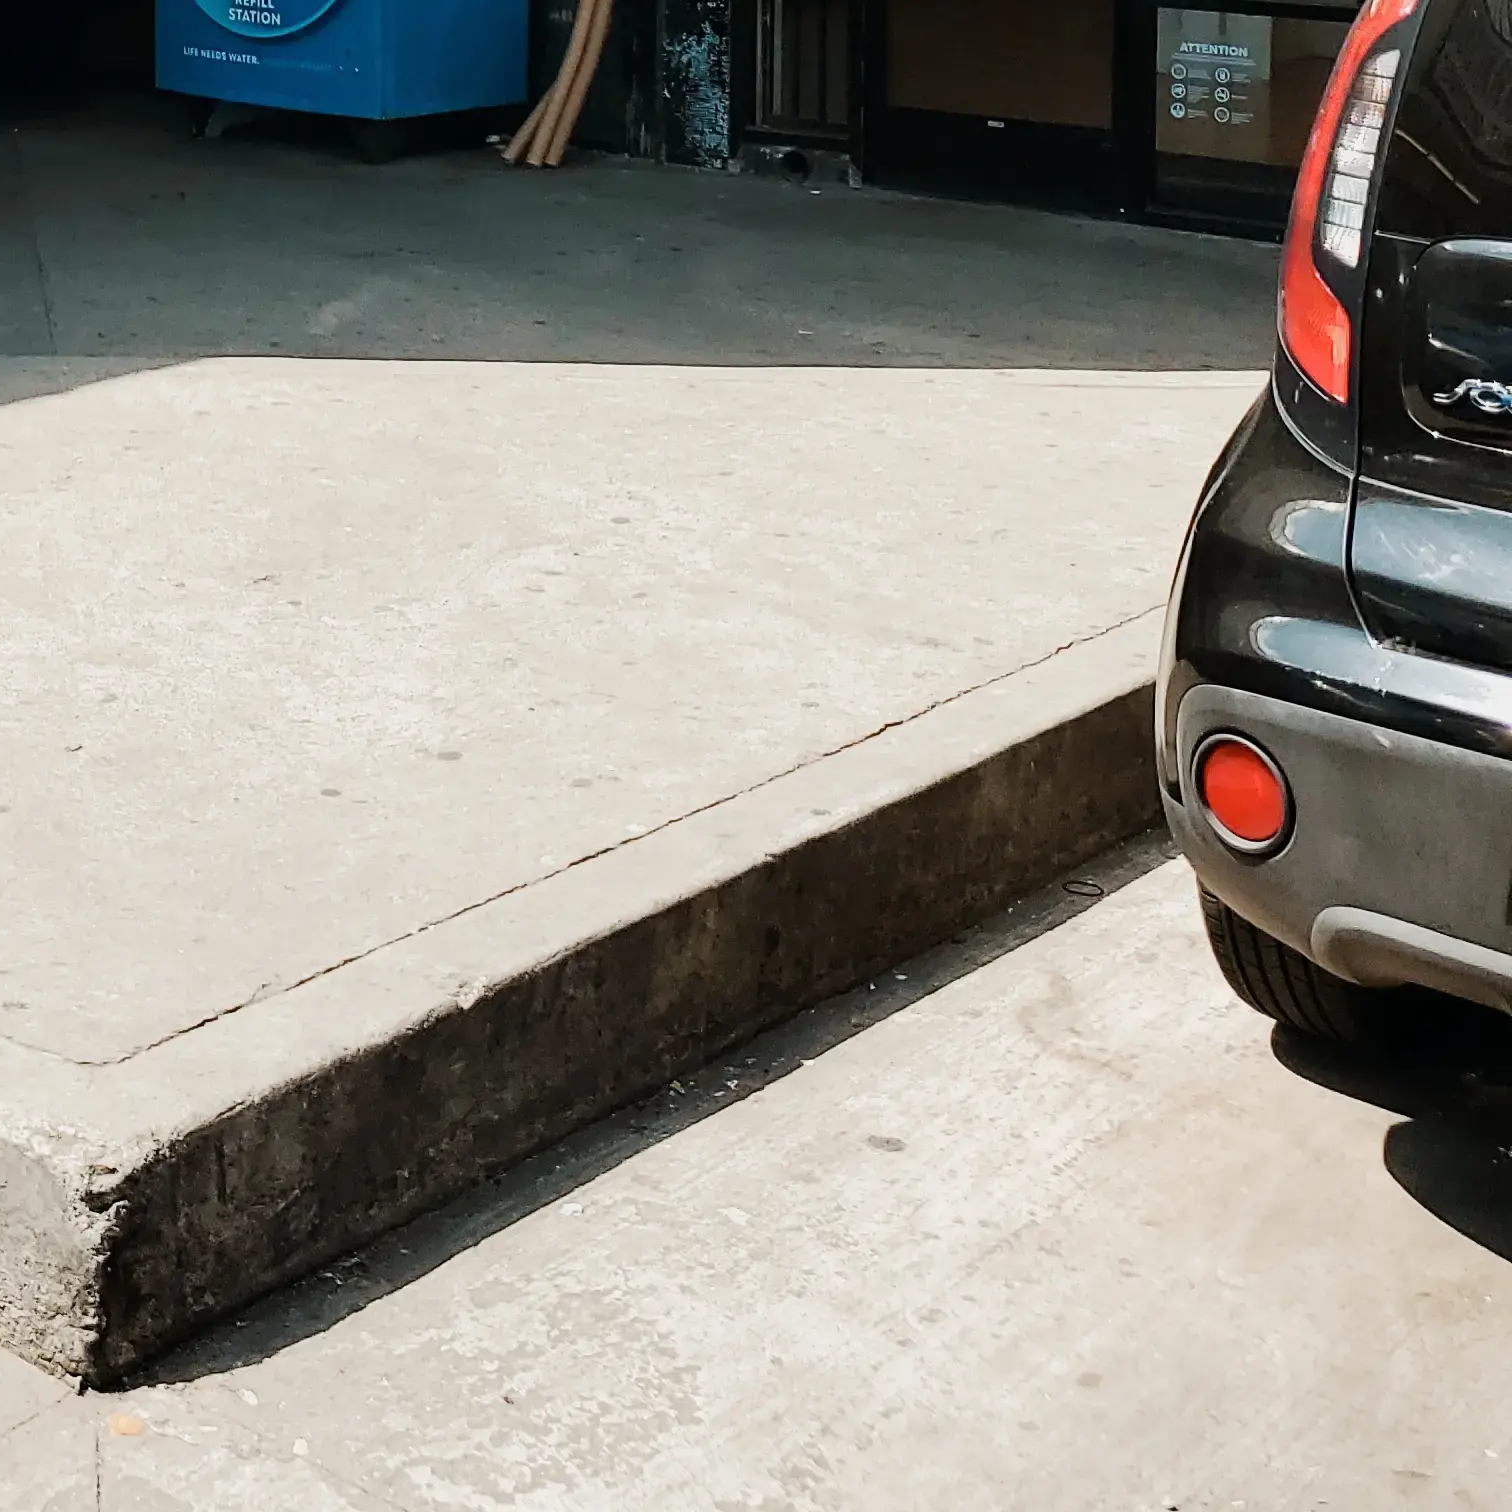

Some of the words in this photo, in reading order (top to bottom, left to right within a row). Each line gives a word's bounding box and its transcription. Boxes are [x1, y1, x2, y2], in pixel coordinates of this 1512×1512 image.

[228, 8, 281, 26] STATION
[183, 45, 198, 57] LIFE
[200, 49, 227, 61] NEEDS
[1179, 42, 1248, 57] ATTENTION
